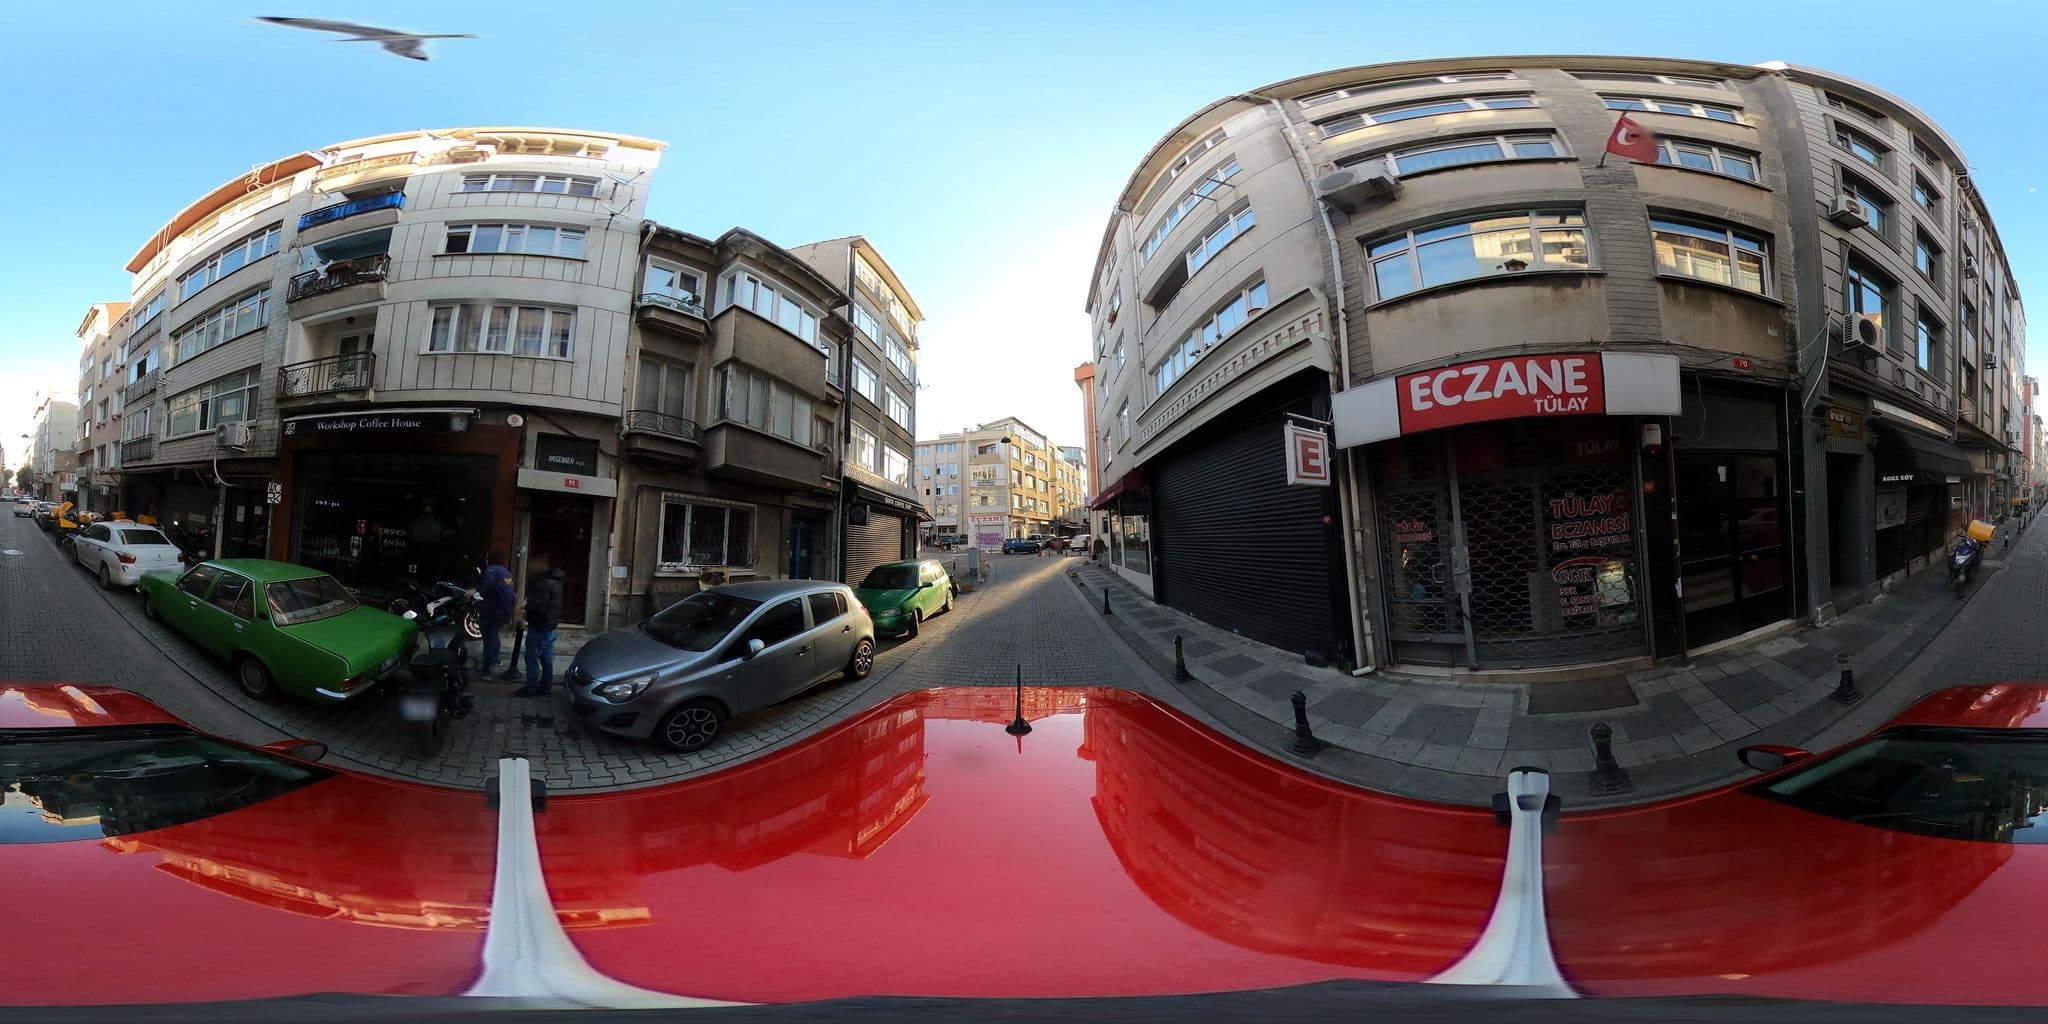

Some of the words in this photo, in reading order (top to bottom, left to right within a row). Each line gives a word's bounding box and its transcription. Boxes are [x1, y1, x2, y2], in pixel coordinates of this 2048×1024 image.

[1410, 359, 1589, 412] ECZANE
[1534, 395, 1589, 414] TÜLAY
[317, 419, 357, 432] Workshop
[359, 417, 389, 429] Coffee
[391, 417, 421, 428] House
[1301, 440, 1322, 474] E
[1576, 437, 1622, 456] TÜLAY
[1551, 491, 1615, 518] TÜLAY
[1552, 513, 1630, 539] ECZANESİ
[1559, 567, 1594, 584] SGK
